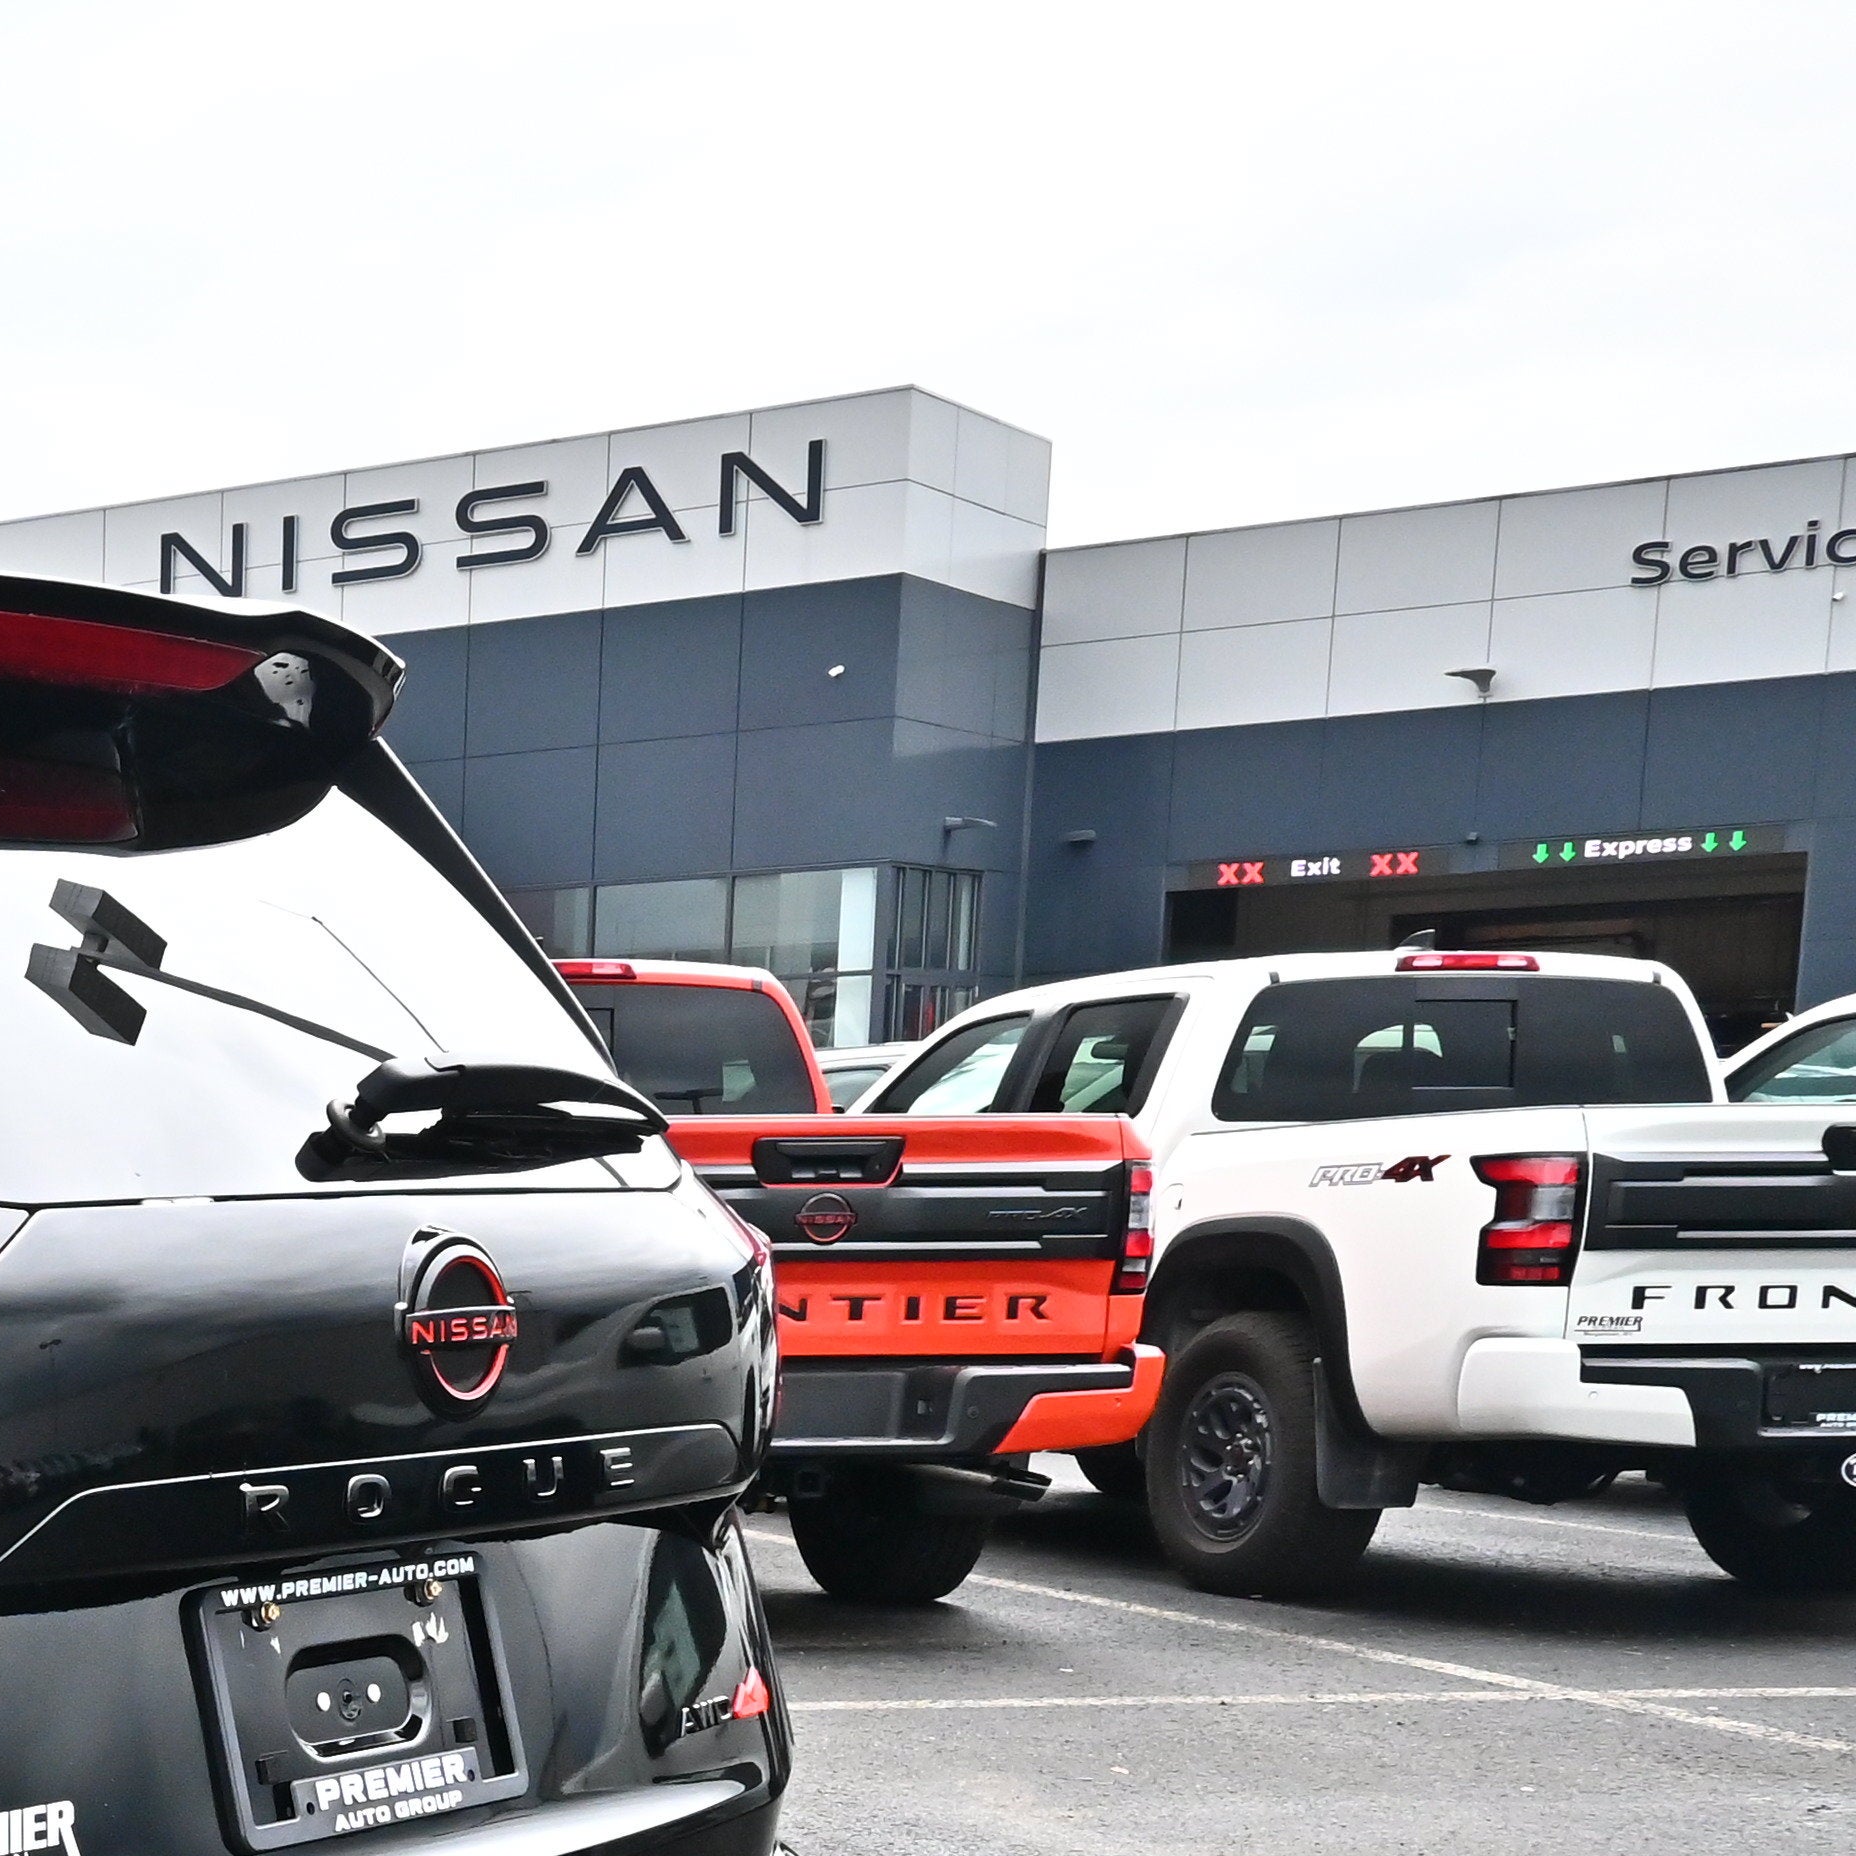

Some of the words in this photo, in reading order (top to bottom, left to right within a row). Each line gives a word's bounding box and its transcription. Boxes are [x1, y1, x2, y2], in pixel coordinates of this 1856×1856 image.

[160, 438, 826, 597] NISSAN
[1290, 856, 1341, 877] Exit
[1584, 836, 1692, 859] Express
[1308, 1154, 1452, 1187] PRO-4X
[411, 1312, 517, 1344] NISSAN
[1577, 1316, 1643, 1327] PREMIER
[239, 1447, 635, 1532] ROGUE
[221, 1556, 475, 1607] WWW.PREMIER-AUTO.COM
[681, 1695, 732, 1737] AWD
[315, 1753, 467, 1811] PREMIER
[335, 1802, 391, 1832] AUTO
[395, 1789, 463, 1818] GROUP
